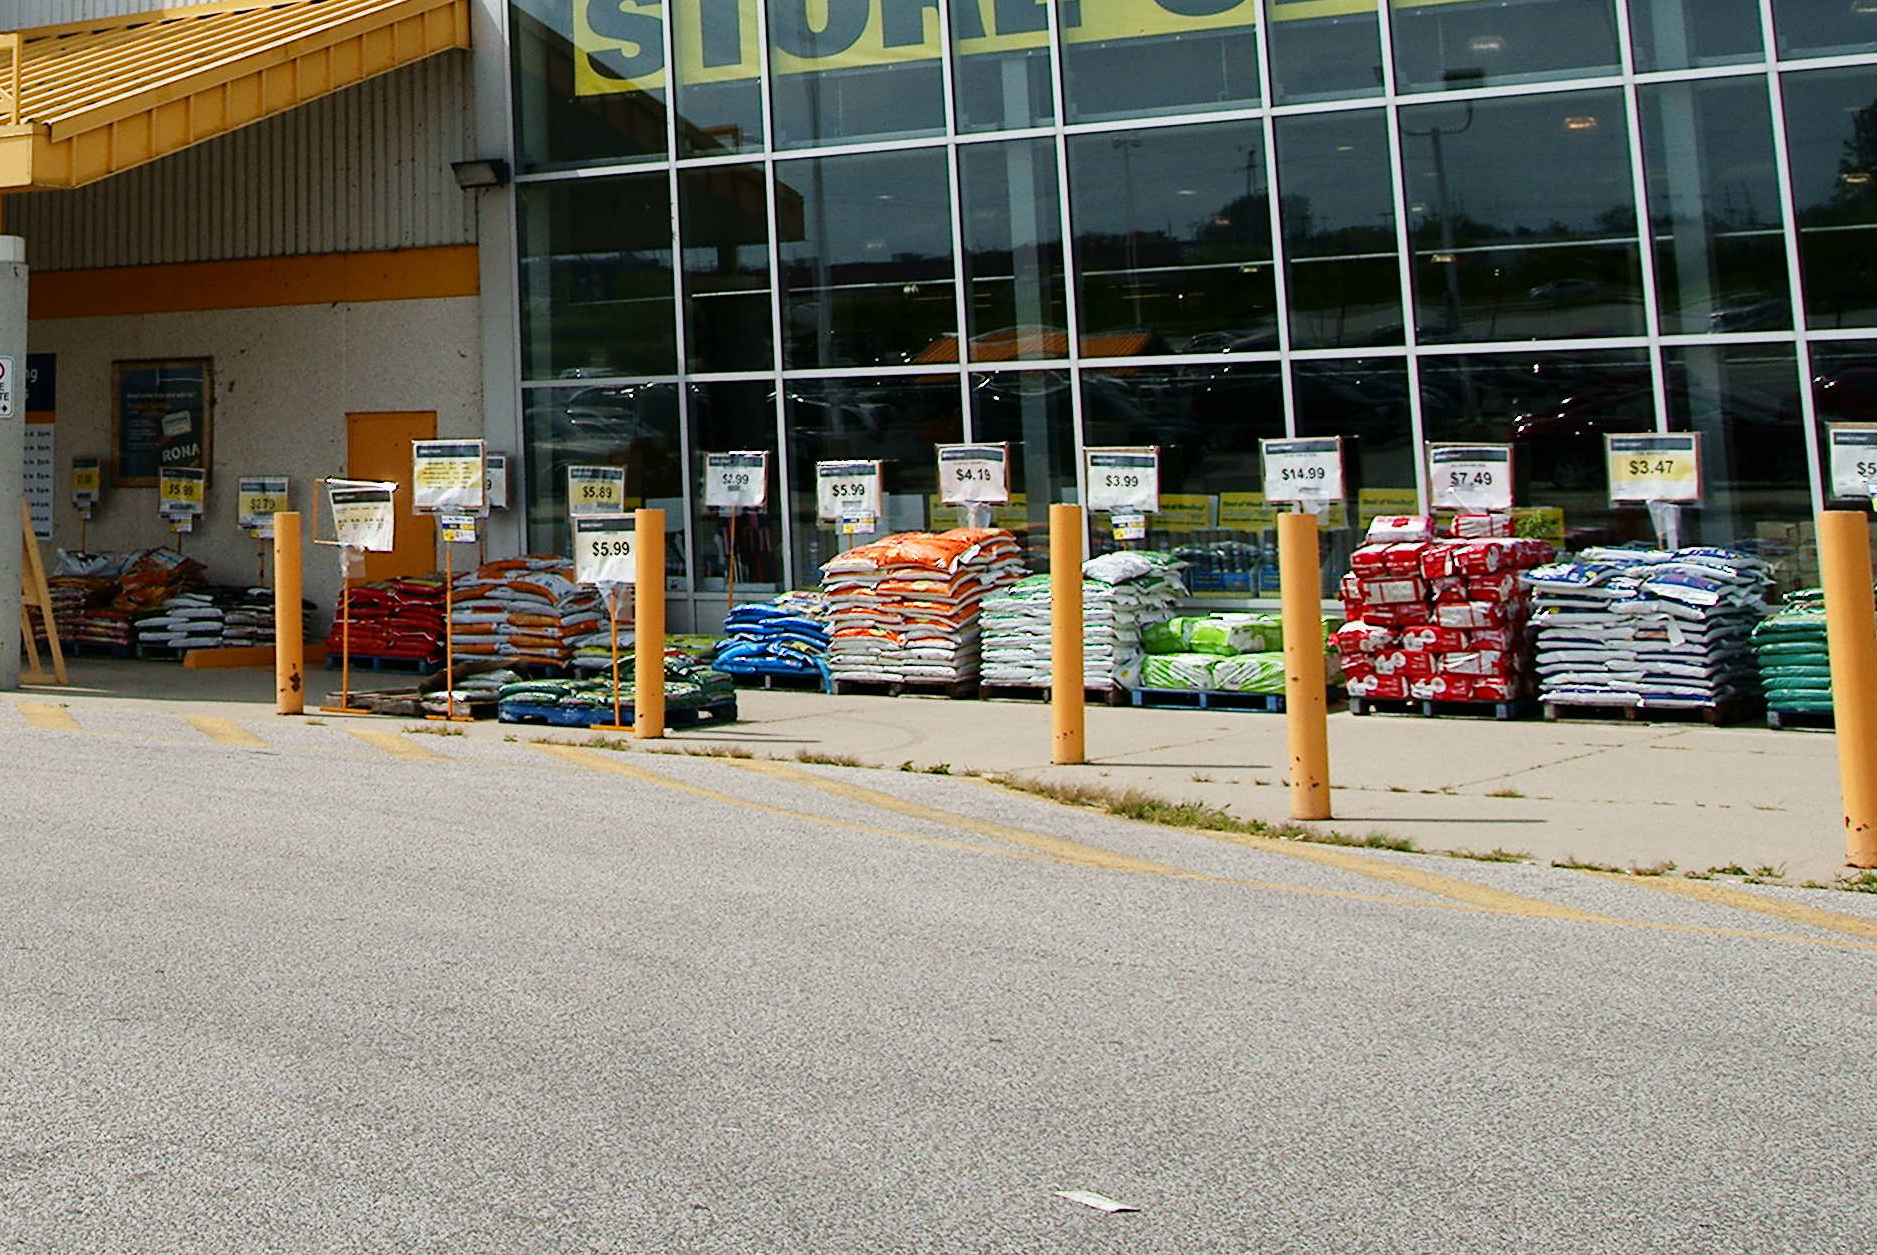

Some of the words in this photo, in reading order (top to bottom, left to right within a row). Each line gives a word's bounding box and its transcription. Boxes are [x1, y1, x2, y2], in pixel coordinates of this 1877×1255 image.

[162, 443, 201, 462] RONA
[1281, 467, 1326, 481] $14.99
[1629, 459, 1674, 475] $3.47
[1105, 474, 1139, 488] $3.99
[1450, 471, 1493, 487] $7.49
[832, 483, 866, 497] $5.99
[592, 541, 630, 557] $5.99
